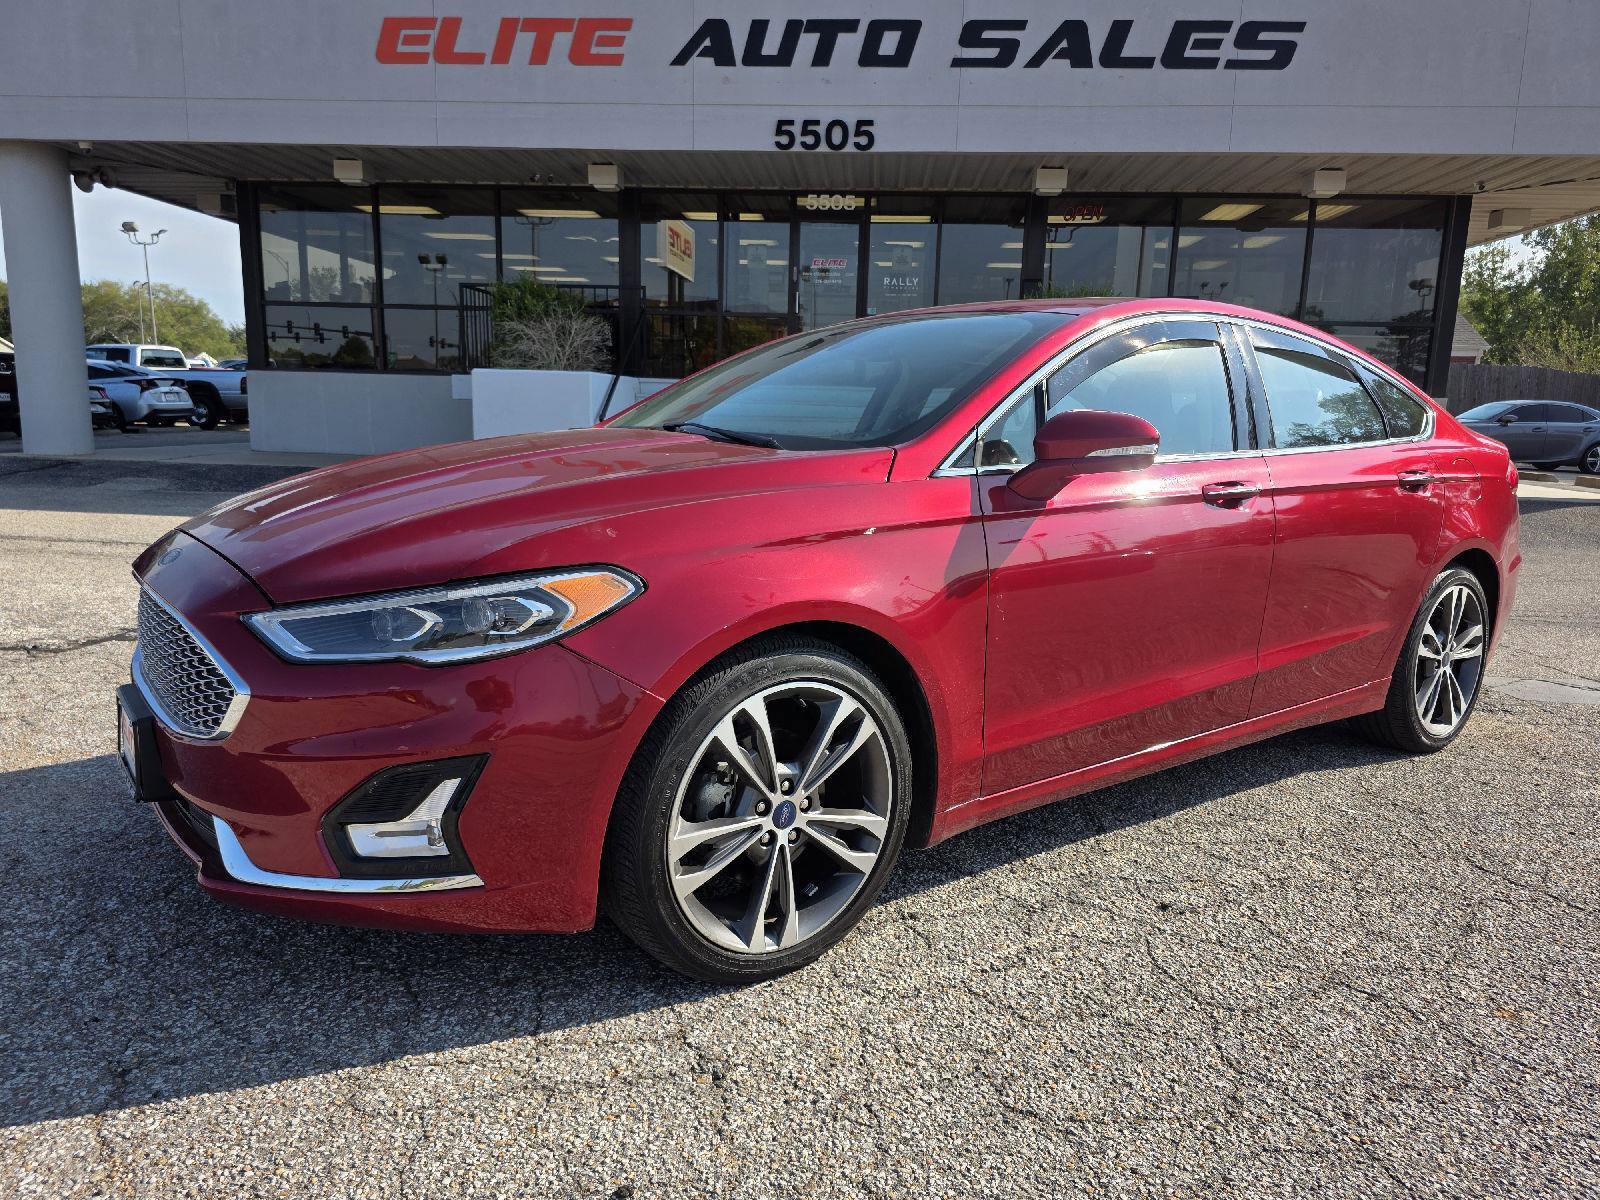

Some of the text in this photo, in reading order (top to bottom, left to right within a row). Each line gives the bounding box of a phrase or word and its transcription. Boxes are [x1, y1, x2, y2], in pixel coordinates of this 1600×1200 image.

[375, 16, 1307, 71] ELITE AUTO SALES
[774, 119, 875, 152] 5505
[806, 194, 856, 211] 5505
[1063, 205, 1104, 222] OPEN
[883, 277, 919, 286] RALLY
